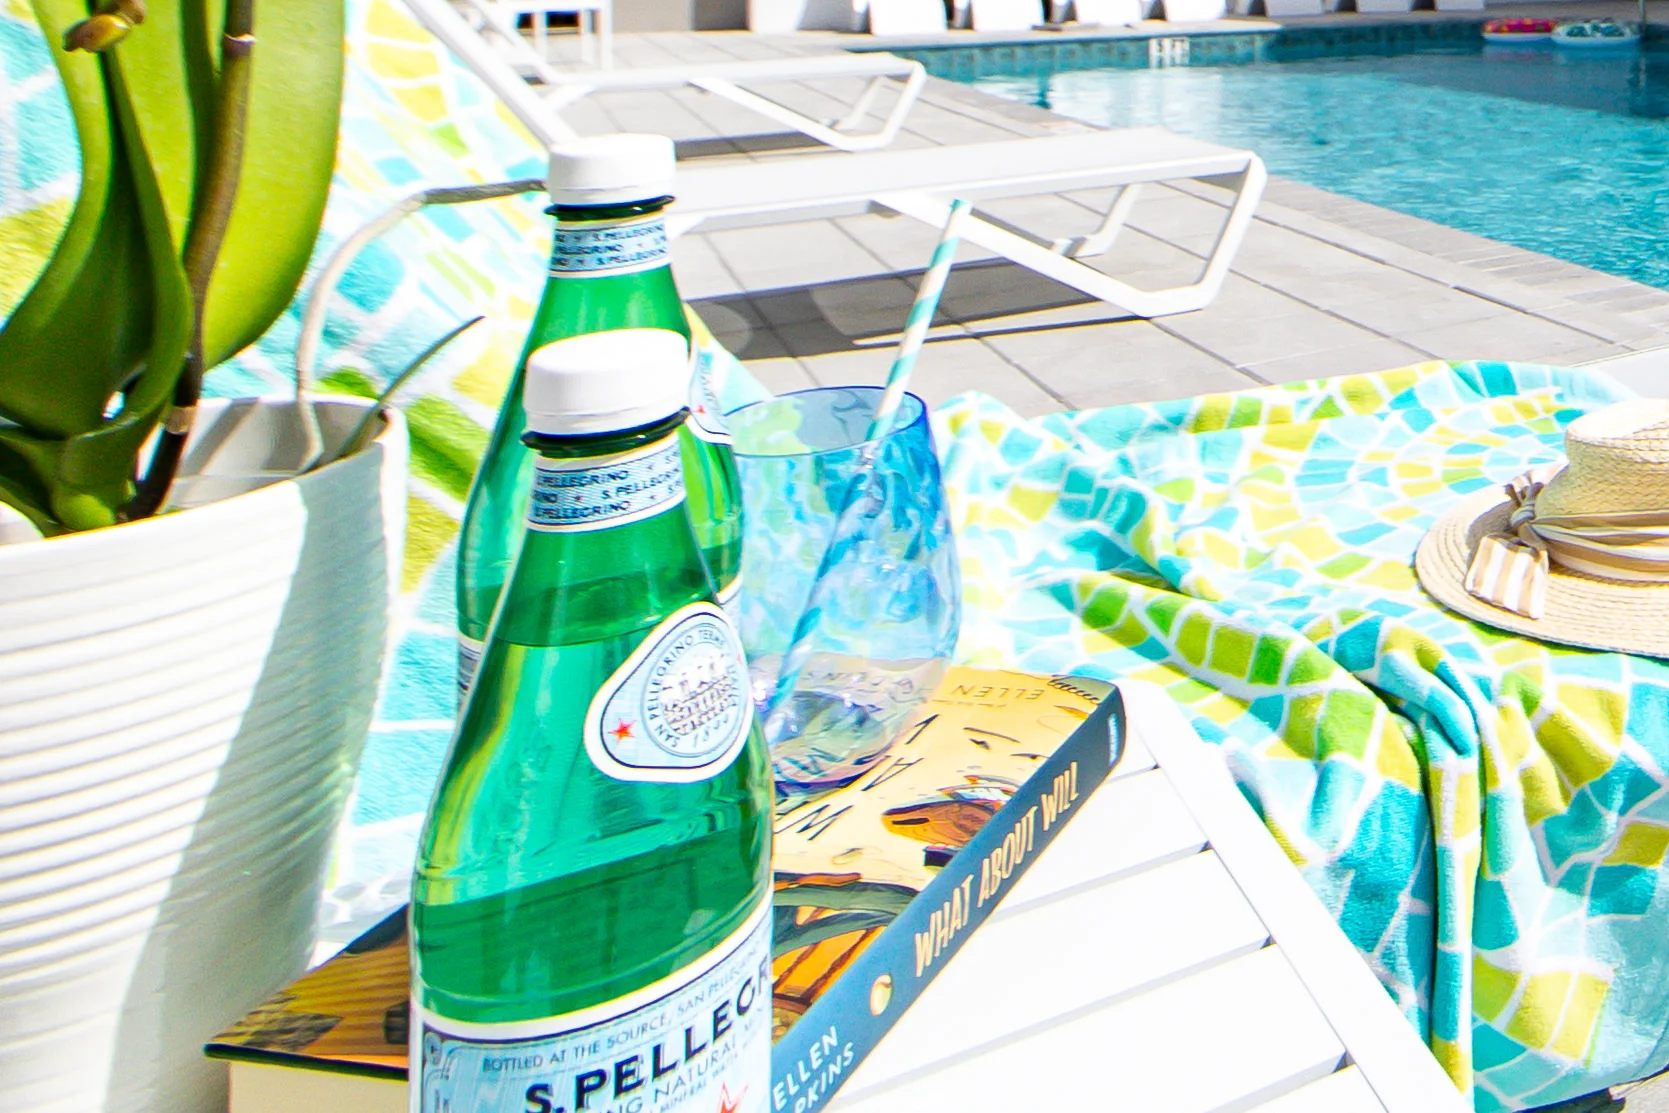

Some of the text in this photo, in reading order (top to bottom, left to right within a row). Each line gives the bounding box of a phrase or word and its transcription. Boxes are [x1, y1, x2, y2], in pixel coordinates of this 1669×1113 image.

[956, 684, 1046, 702] ELLEN
[914, 761, 1080, 978] WHAT ABOUT WILL
[482, 1054, 544, 1073] BOTTLED
[549, 1049, 567, 1064] AT
[574, 1041, 602, 1059] THE
[772, 1025, 838, 1111] ELLEN
